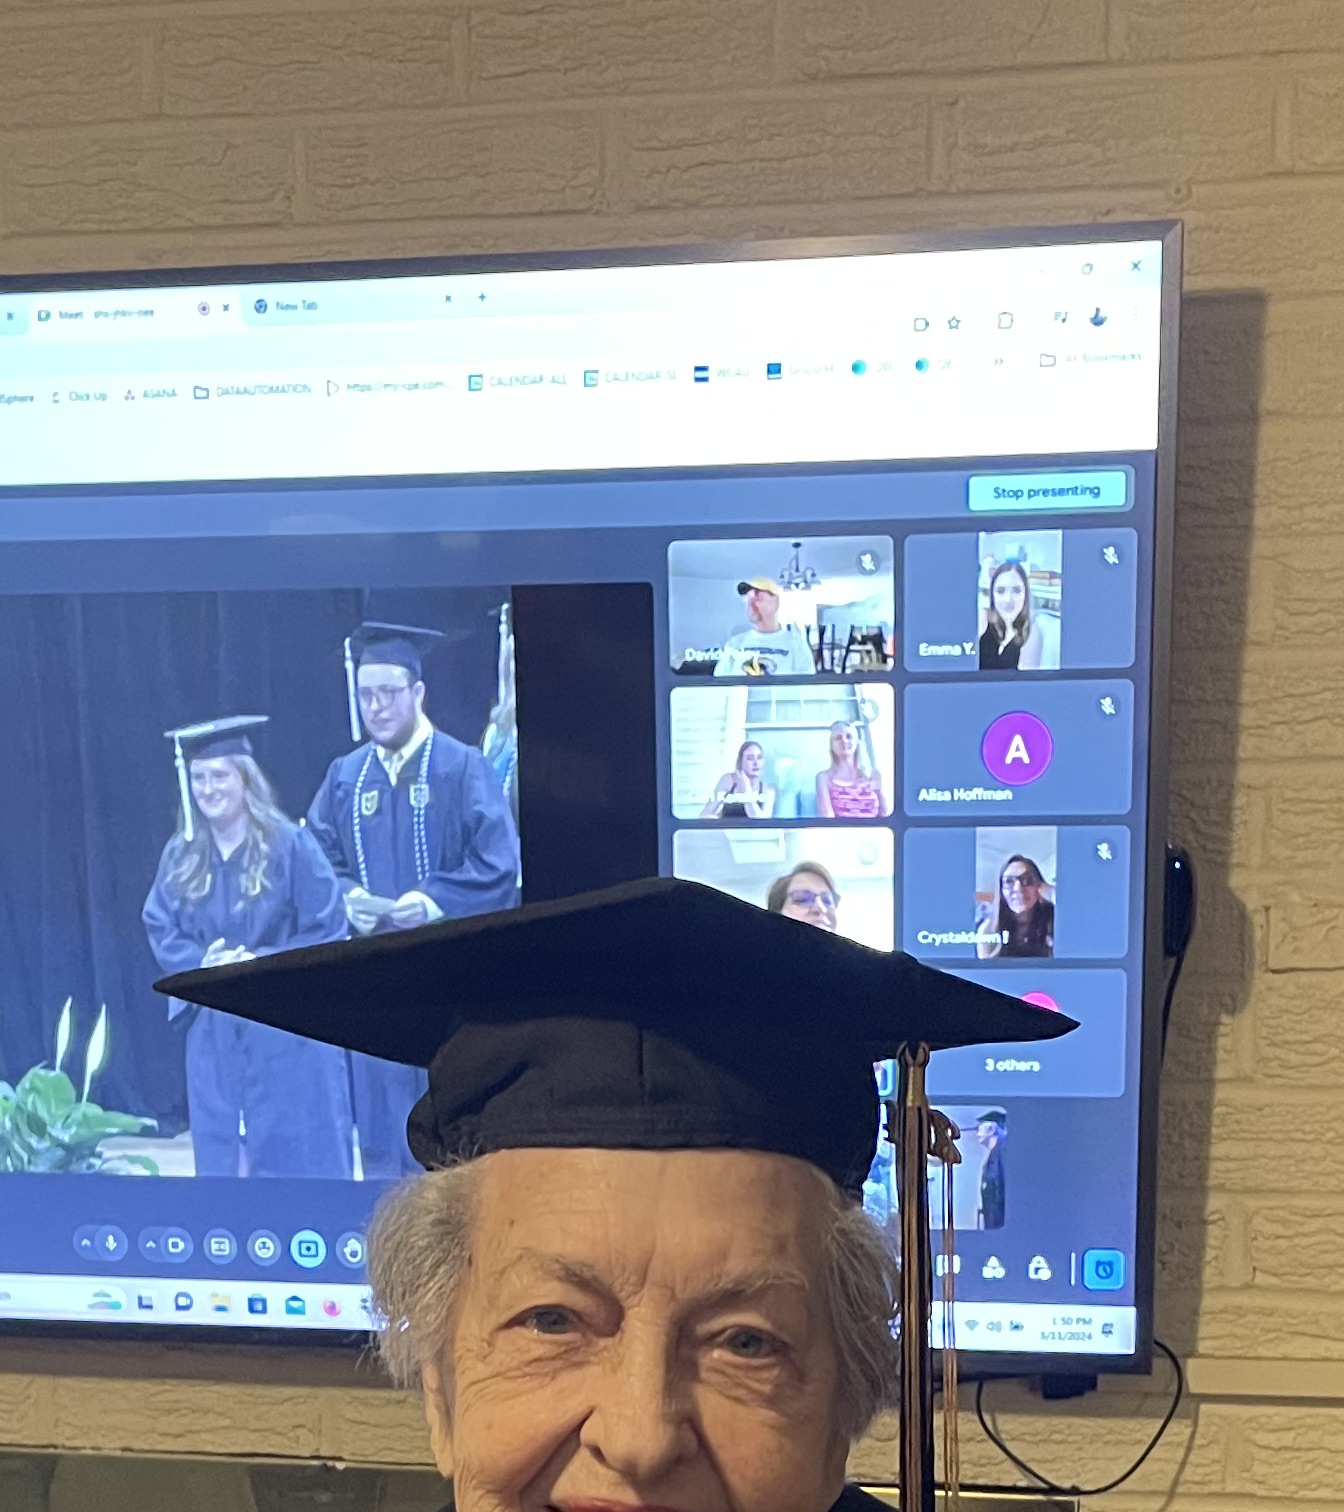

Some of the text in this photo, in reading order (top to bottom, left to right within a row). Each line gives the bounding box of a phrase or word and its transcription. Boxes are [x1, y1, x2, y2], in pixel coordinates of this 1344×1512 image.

[275, 299, 318, 311] New Tab
[993, 484, 1101, 501] Stop presenting
[919, 642, 977, 657] Emma Y.
[1005, 733, 1030, 765] A
[918, 786, 1014, 802] Alisa Hoffman
[985, 1057, 1041, 1073] 3 others
[1075, 1317, 1093, 1326] PM
